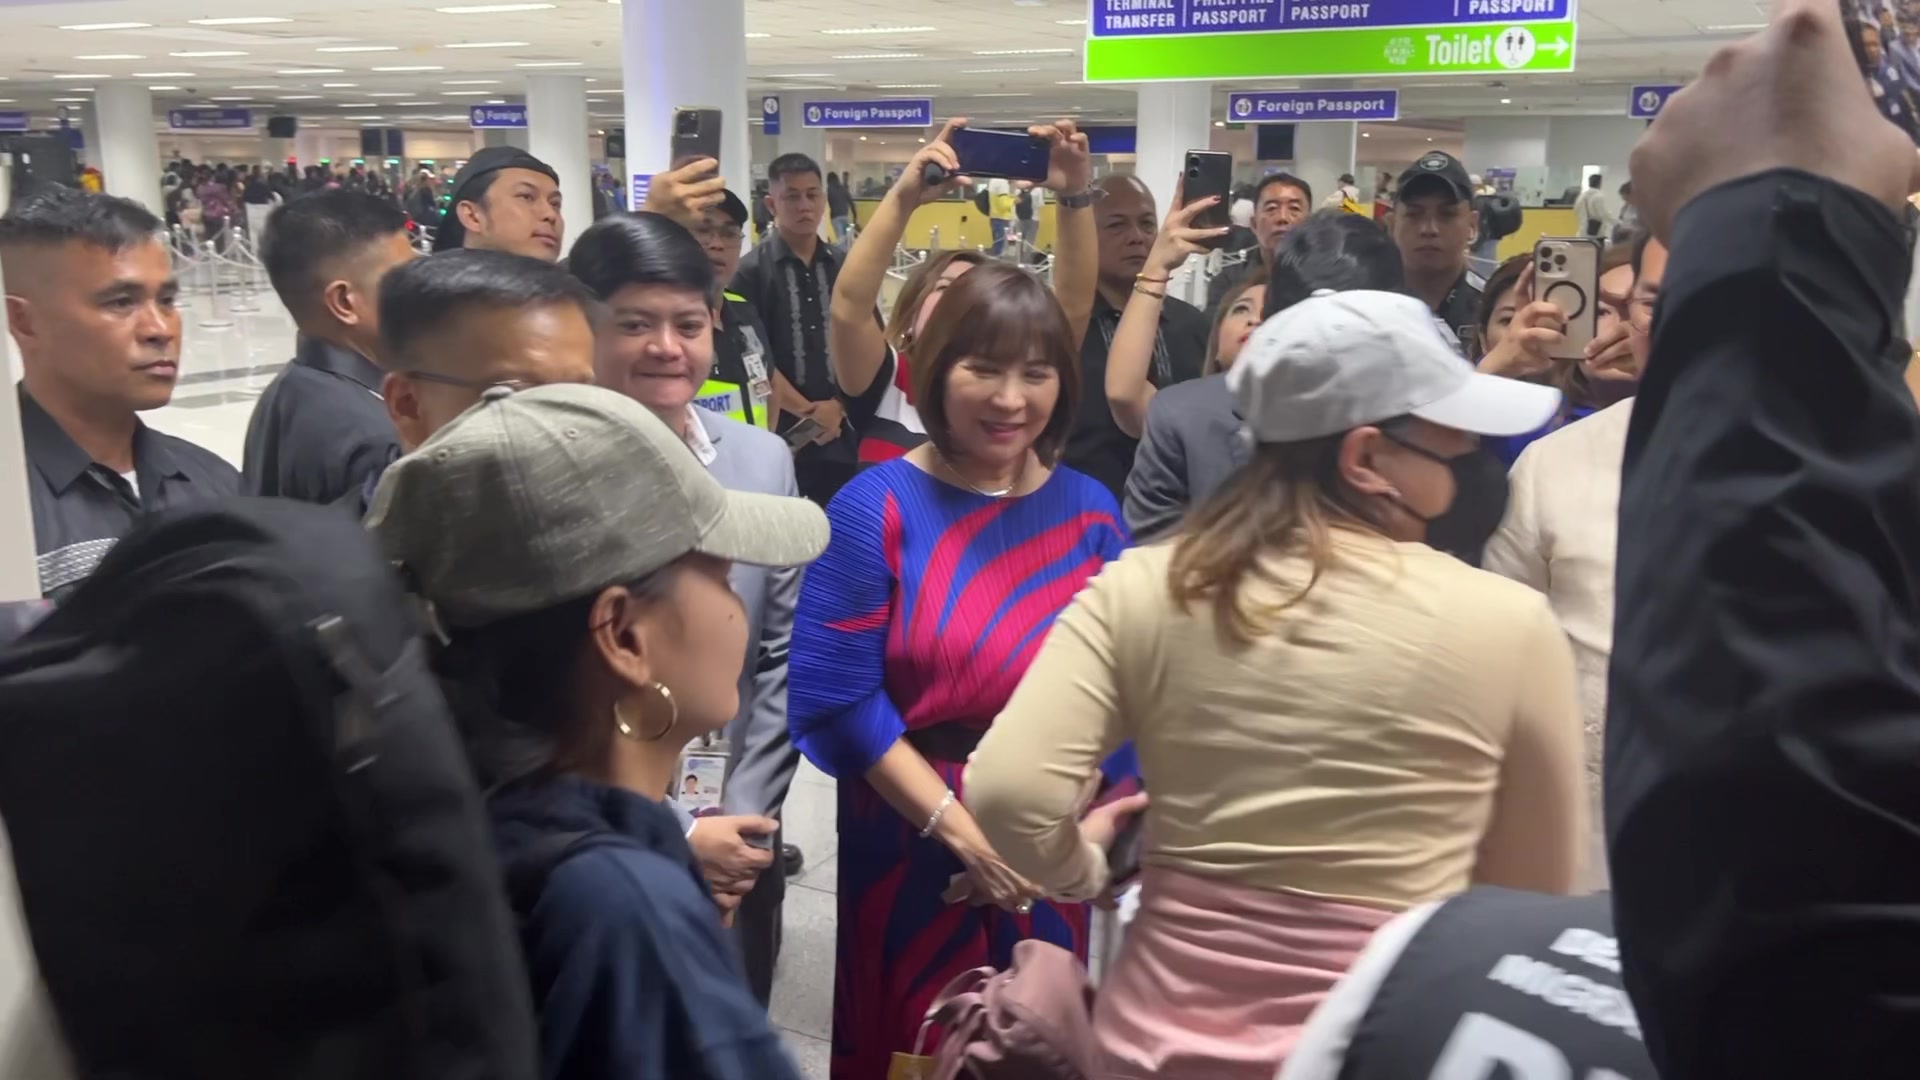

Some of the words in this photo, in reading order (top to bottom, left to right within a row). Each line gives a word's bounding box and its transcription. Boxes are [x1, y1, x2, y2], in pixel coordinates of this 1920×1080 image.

[1105, 0, 1175, 11] TERMINAL
[1291, 4, 1370, 20] PASSPORT
[1469, 0, 1554, 15] PASSPORT
[1105, 13, 1175, 29] TRANSFER
[1192, 9, 1266, 25] PASSPORT
[1425, 33, 1492, 65] Toilet
[1257, 97, 1313, 114] Foreign
[1317, 95, 1385, 113] Passport
[824, 107, 868, 121] Foreign
[870, 107, 922, 120] Passport
